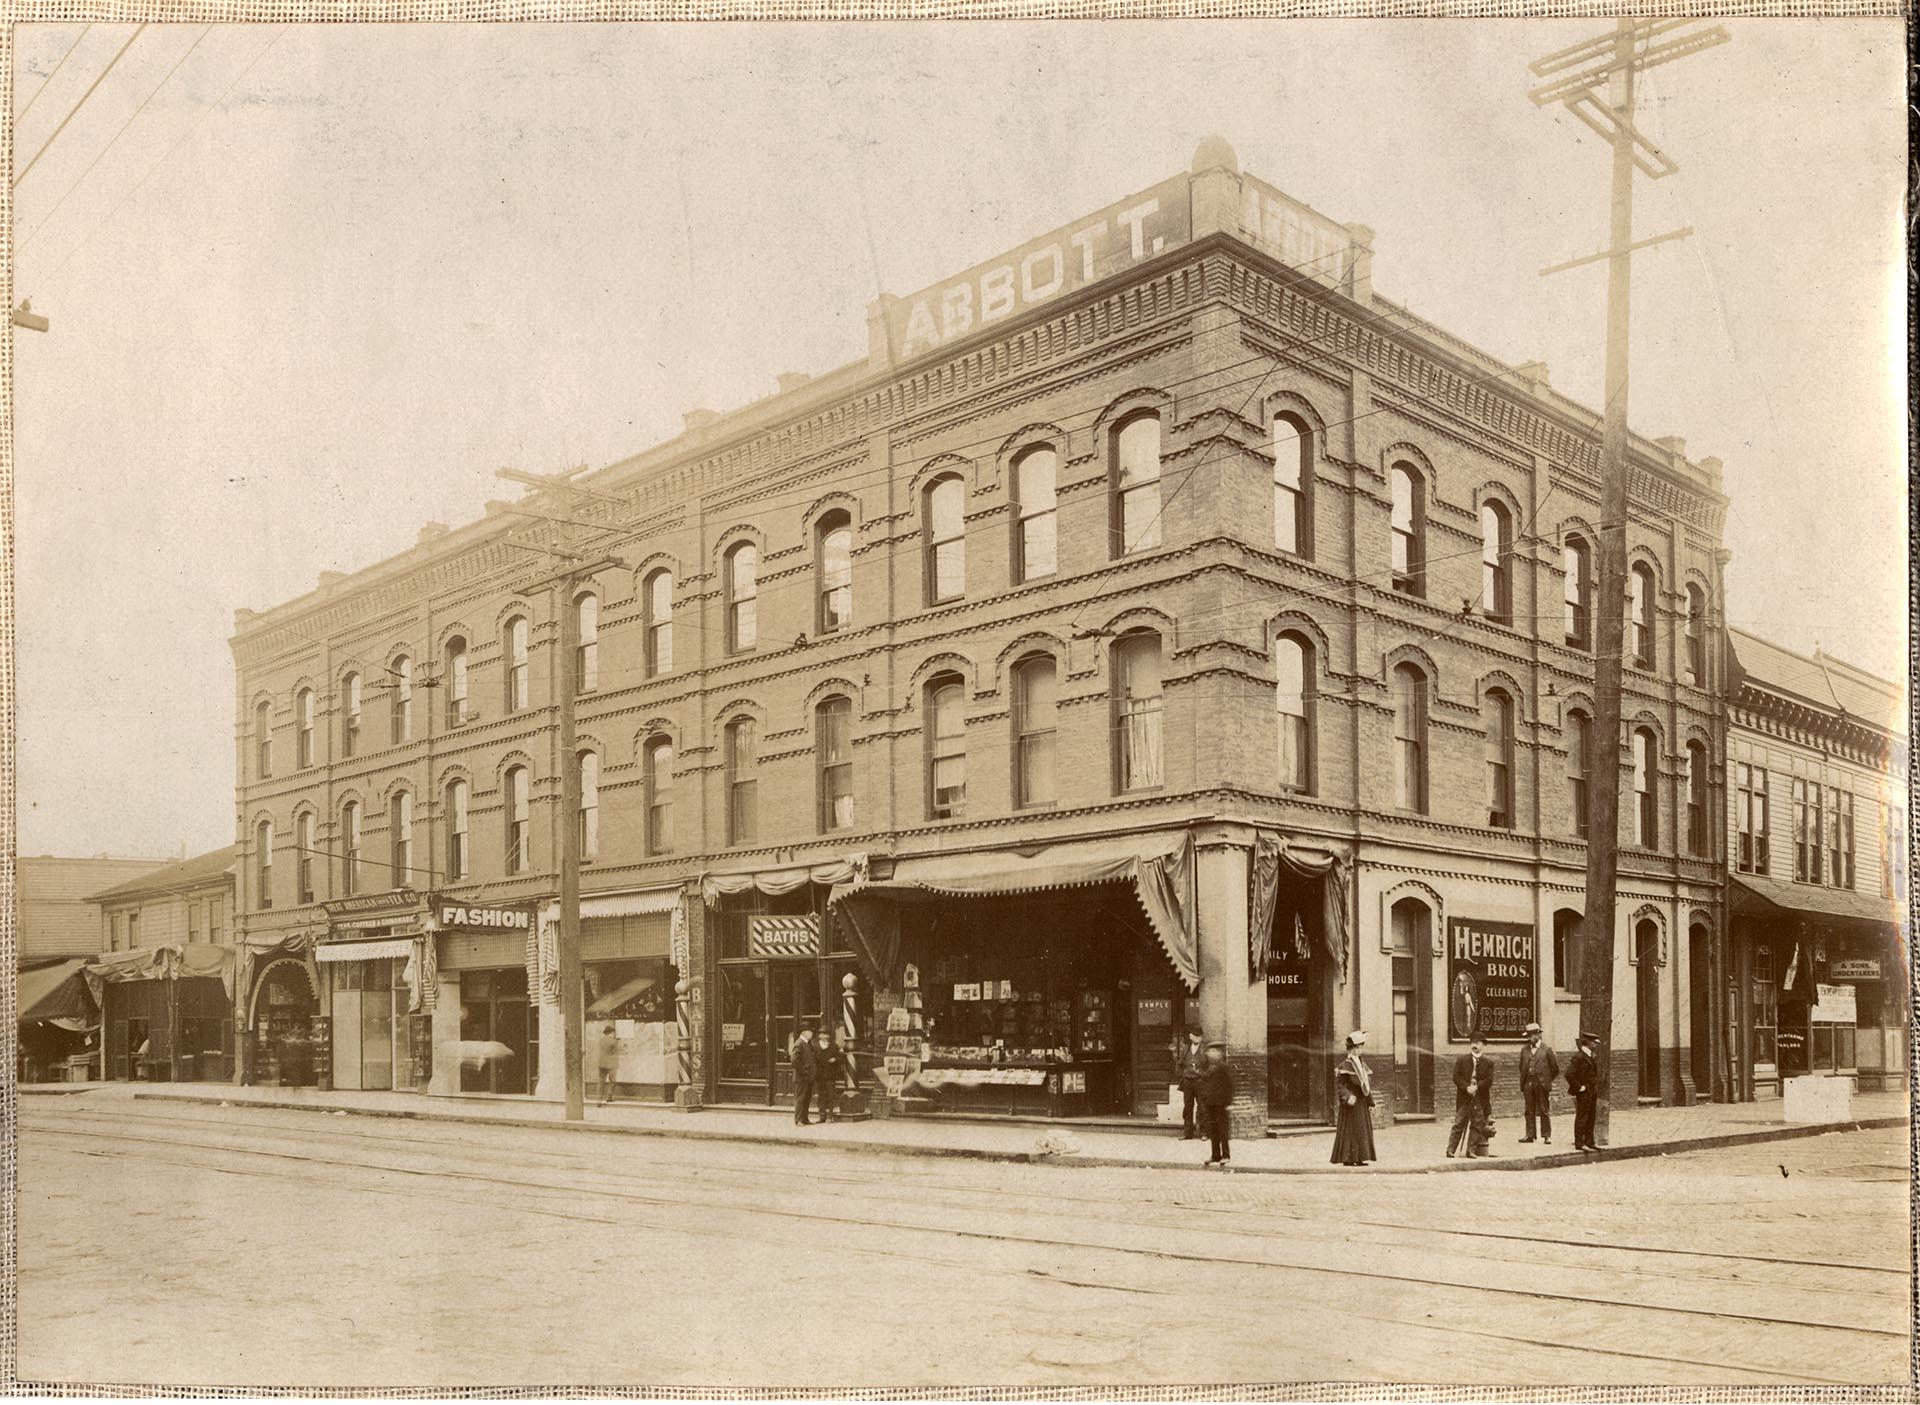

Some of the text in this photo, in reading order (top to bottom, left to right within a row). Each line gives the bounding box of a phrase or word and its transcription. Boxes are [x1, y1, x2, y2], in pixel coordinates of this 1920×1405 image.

[442, 907, 528, 929] FASHION
[762, 930, 809, 944] BATHS
[1454, 926, 1533, 965] HEMRICH
[1269, 950, 1288, 960] ILY
[1487, 963, 1530, 978] BROS.
[1268, 974, 1303, 985] HOUSE.
[1485, 987, 1528, 999] CELEBRATED
[1480, 1007, 1530, 1031] BEER
